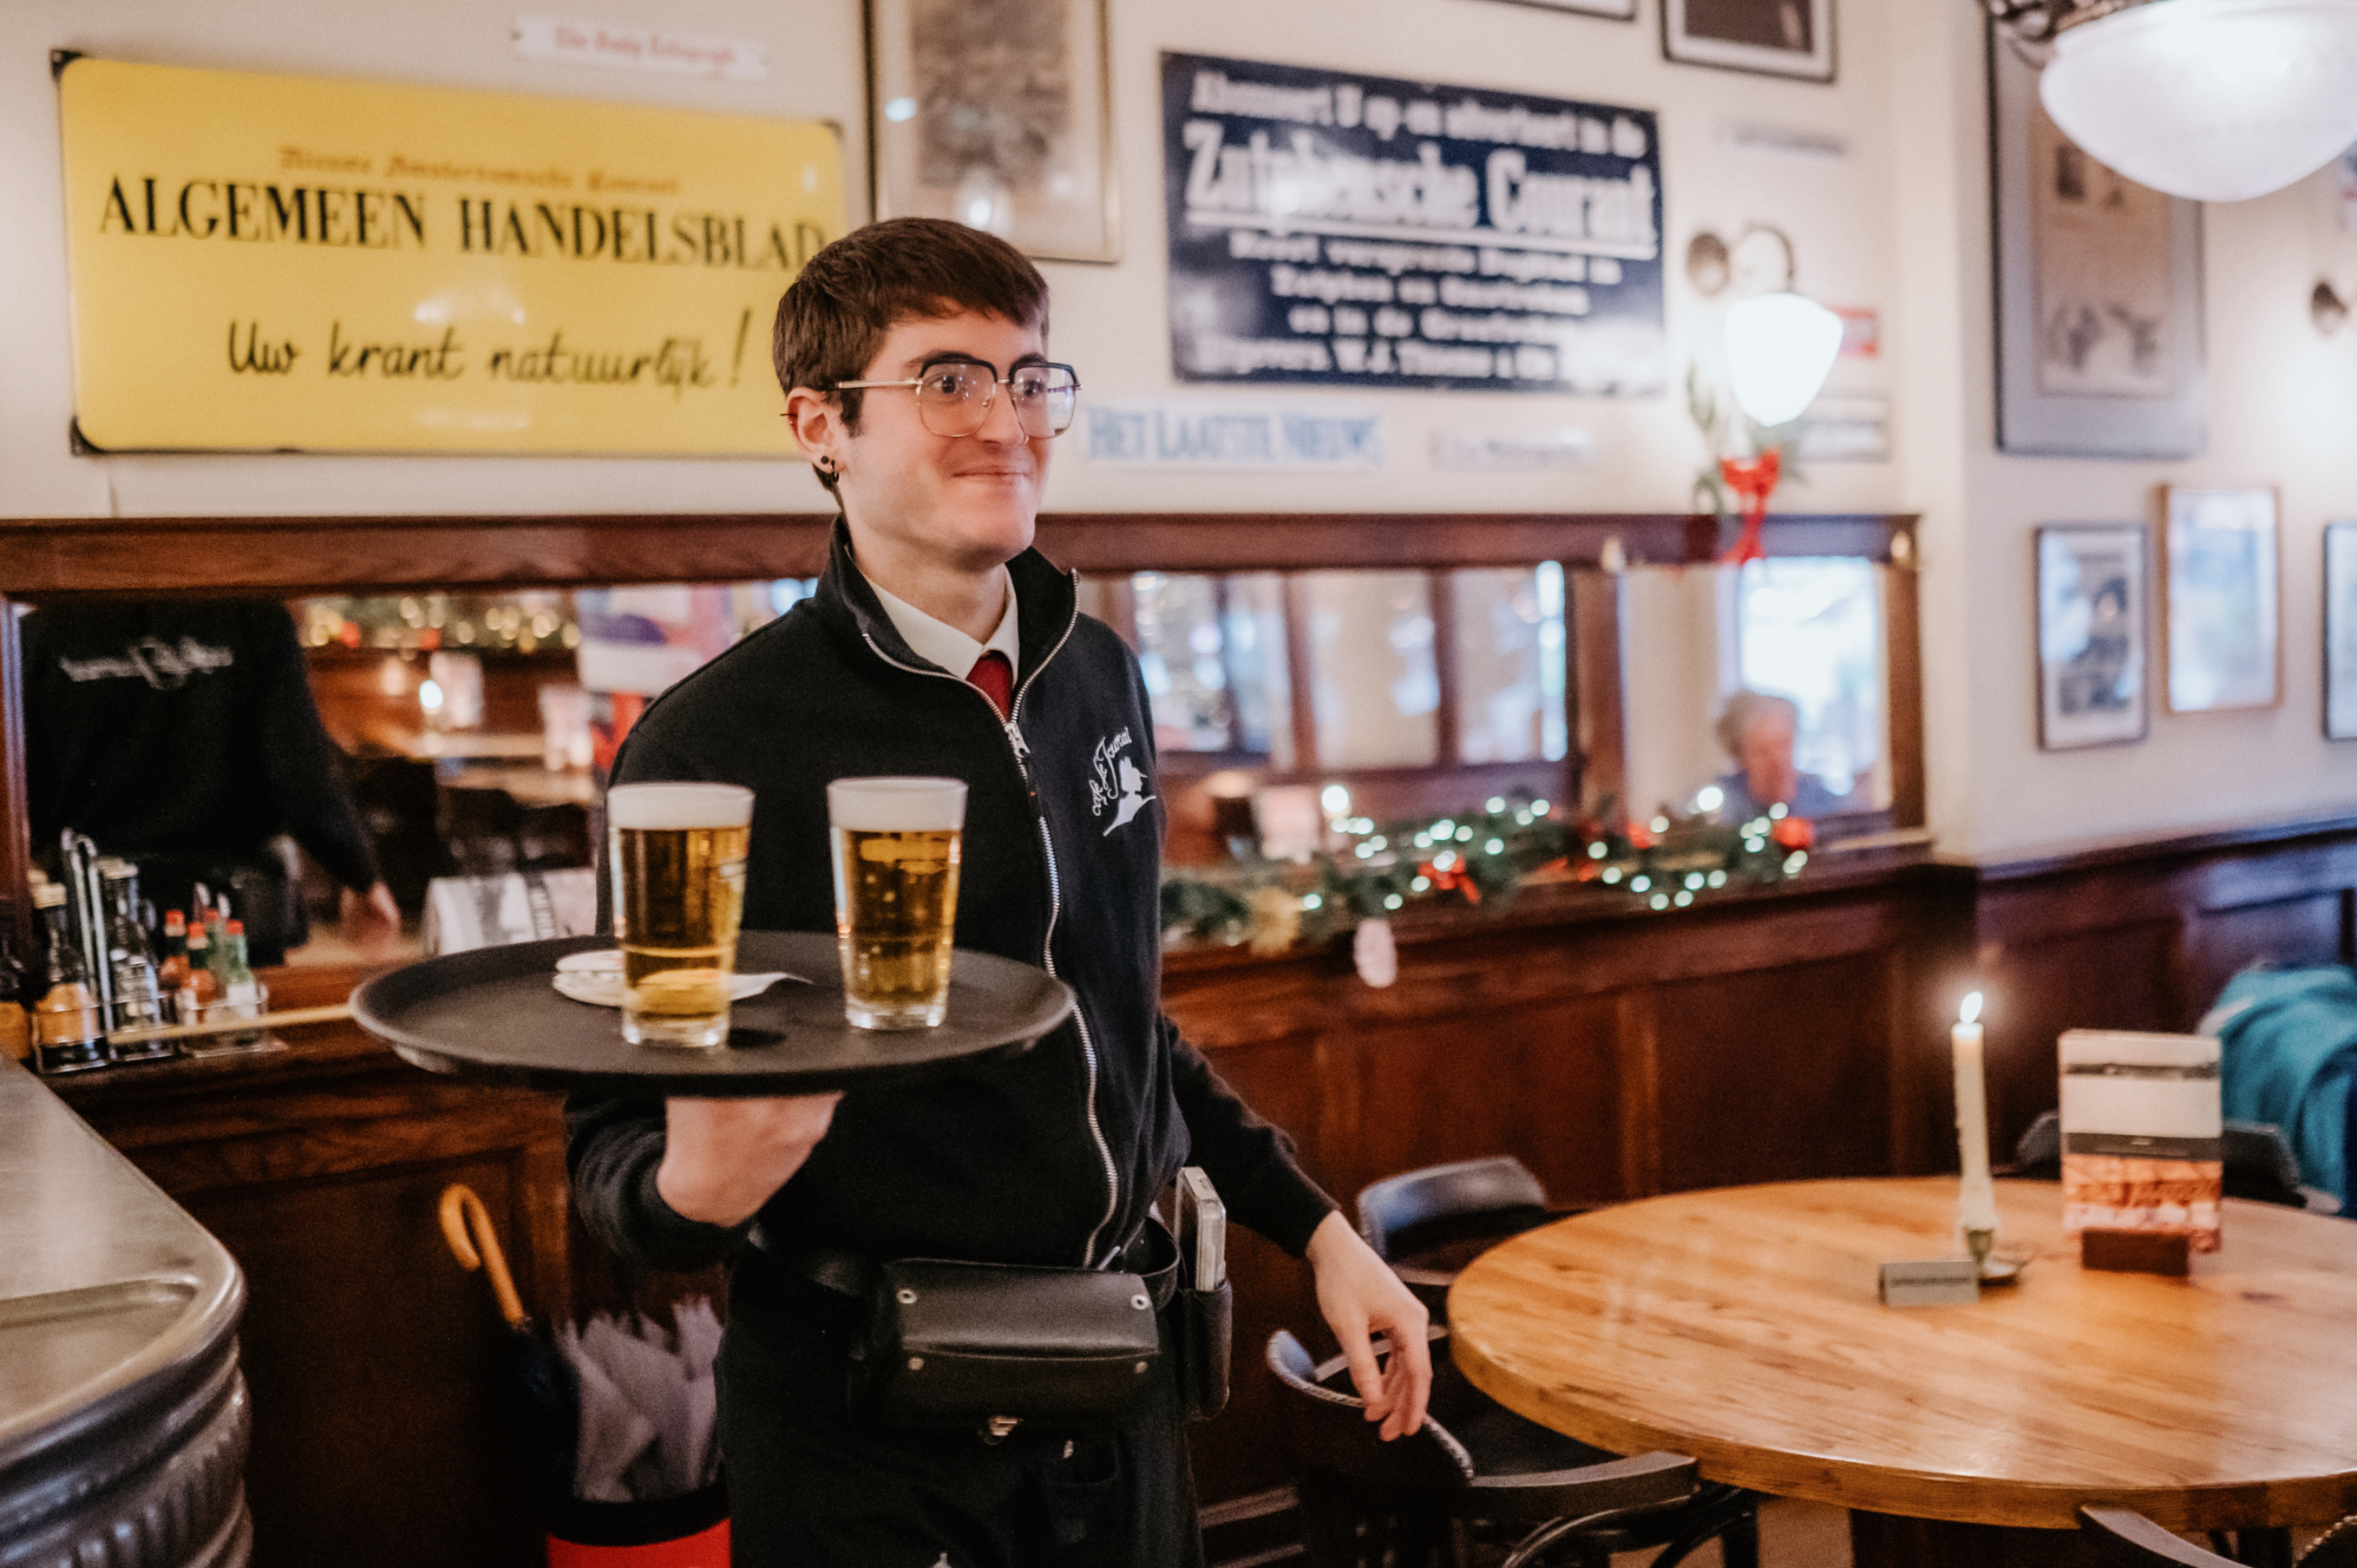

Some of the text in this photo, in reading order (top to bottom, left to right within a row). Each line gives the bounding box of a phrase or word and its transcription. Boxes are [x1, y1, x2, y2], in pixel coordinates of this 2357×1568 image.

[100, 173, 828, 272] ALGEMEEN HANDELSBLAD
[227, 319, 298, 375] Uw
[327, 318, 465, 381] krant
